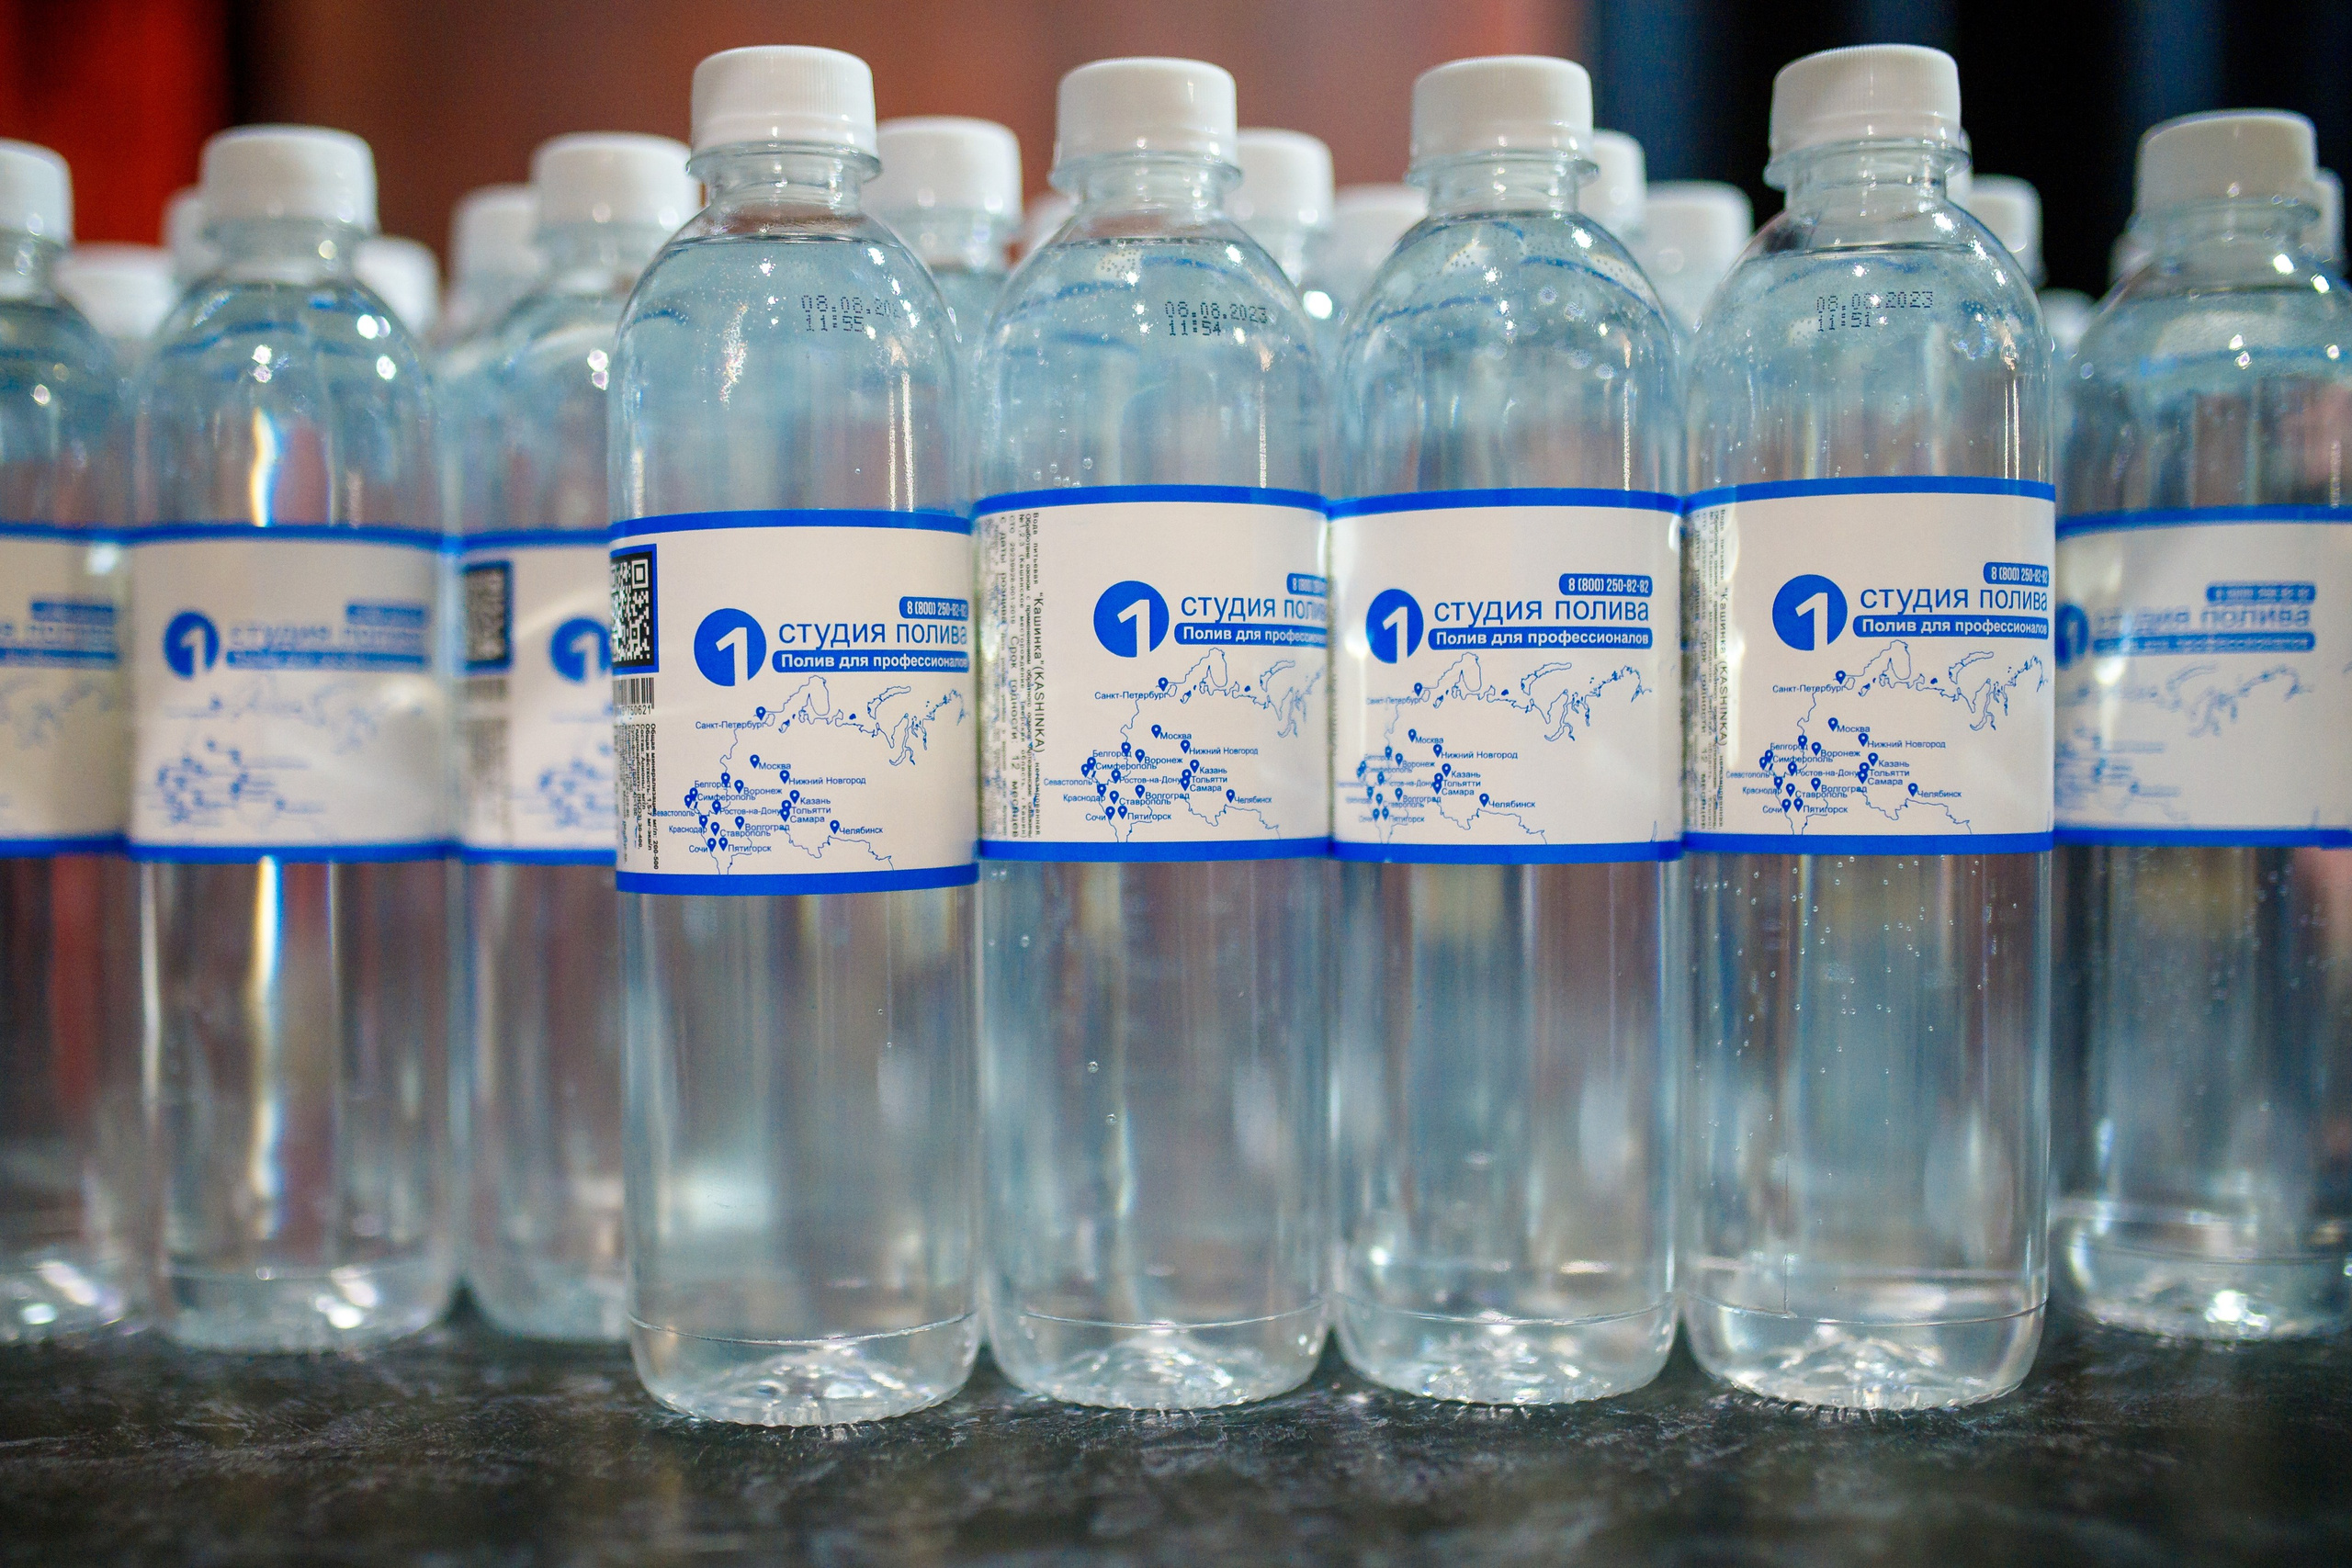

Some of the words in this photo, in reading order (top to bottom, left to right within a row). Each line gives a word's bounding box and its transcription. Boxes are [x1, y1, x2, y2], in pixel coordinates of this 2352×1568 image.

[1991, 566, 1997, 581] 8
[1999, 566, 2019, 581] (800)
[1568, 578, 1576, 591] 8
[1577, 578, 1604, 592] (800)
[1606, 579, 1649, 594] 250-82-82
[1860, 589, 1969, 615] студия
[1980, 589, 2047, 612] полива
[907, 601, 913, 615] 8
[914, 601, 936, 615] (800)
[1181, 596, 1275, 623] студия
[1434, 600, 1543, 627] студия
[1555, 600, 1649, 621] полива
[1862, 618, 1917, 633] Полив
[1920, 618, 1951, 634] для
[1956, 618, 2047, 636] профессионалов
[779, 623, 886, 650] студия
[897, 623, 967, 645] полива
[1183, 626, 1232, 640] Полив
[1236, 626, 1261, 641] для
[1436, 631, 1487, 645] Полив
[1491, 631, 1522, 646] для
[1528, 630, 1649, 645] профессионалов
[781, 654, 835, 669] Полив
[839, 654, 869, 670] для
[1772, 683, 1843, 694] Санкт-Петербург
[1094, 691, 1168, 701] Санкт-Петербург
[695, 721, 765, 730] Санкт-Петербург
[1905, 740, 1946, 749] Новгород
[1223, 748, 1259, 756] Новгород
[1476, 751, 1518, 760] Новгород
[1095, 763, 1158, 772] Симферополь
[788, 777, 823, 785] Нижний
[826, 777, 866, 786] Новгород
[1044, 778, 1092, 786] Севастополь
[743, 787, 783, 795] Воронеж
[1442, 788, 1475, 796] Самара
[1795, 790, 1848, 798] Ставрополь
[697, 794, 756, 802] Симферополь
[1146, 792, 1190, 800] Волгоград
[800, 797, 831, 806] Казань
[1119, 798, 1171, 807] Ставрополь
[1488, 800, 1535, 808] Челябинск
[791, 807, 831, 815] Тольятти
[1762, 806, 1782, 814] Сочи
[1803, 806, 1848, 814] Пятигорск
[789, 816, 825, 824] Самара
[1127, 813, 1171, 821] Пятигорск
[669, 826, 707, 834] Краснодар
[719, 829, 771, 838] Ставрополь
[839, 826, 883, 835] Челябинск
[689, 845, 707, 853] Сочи
[728, 845, 772, 853] Пятигорск
